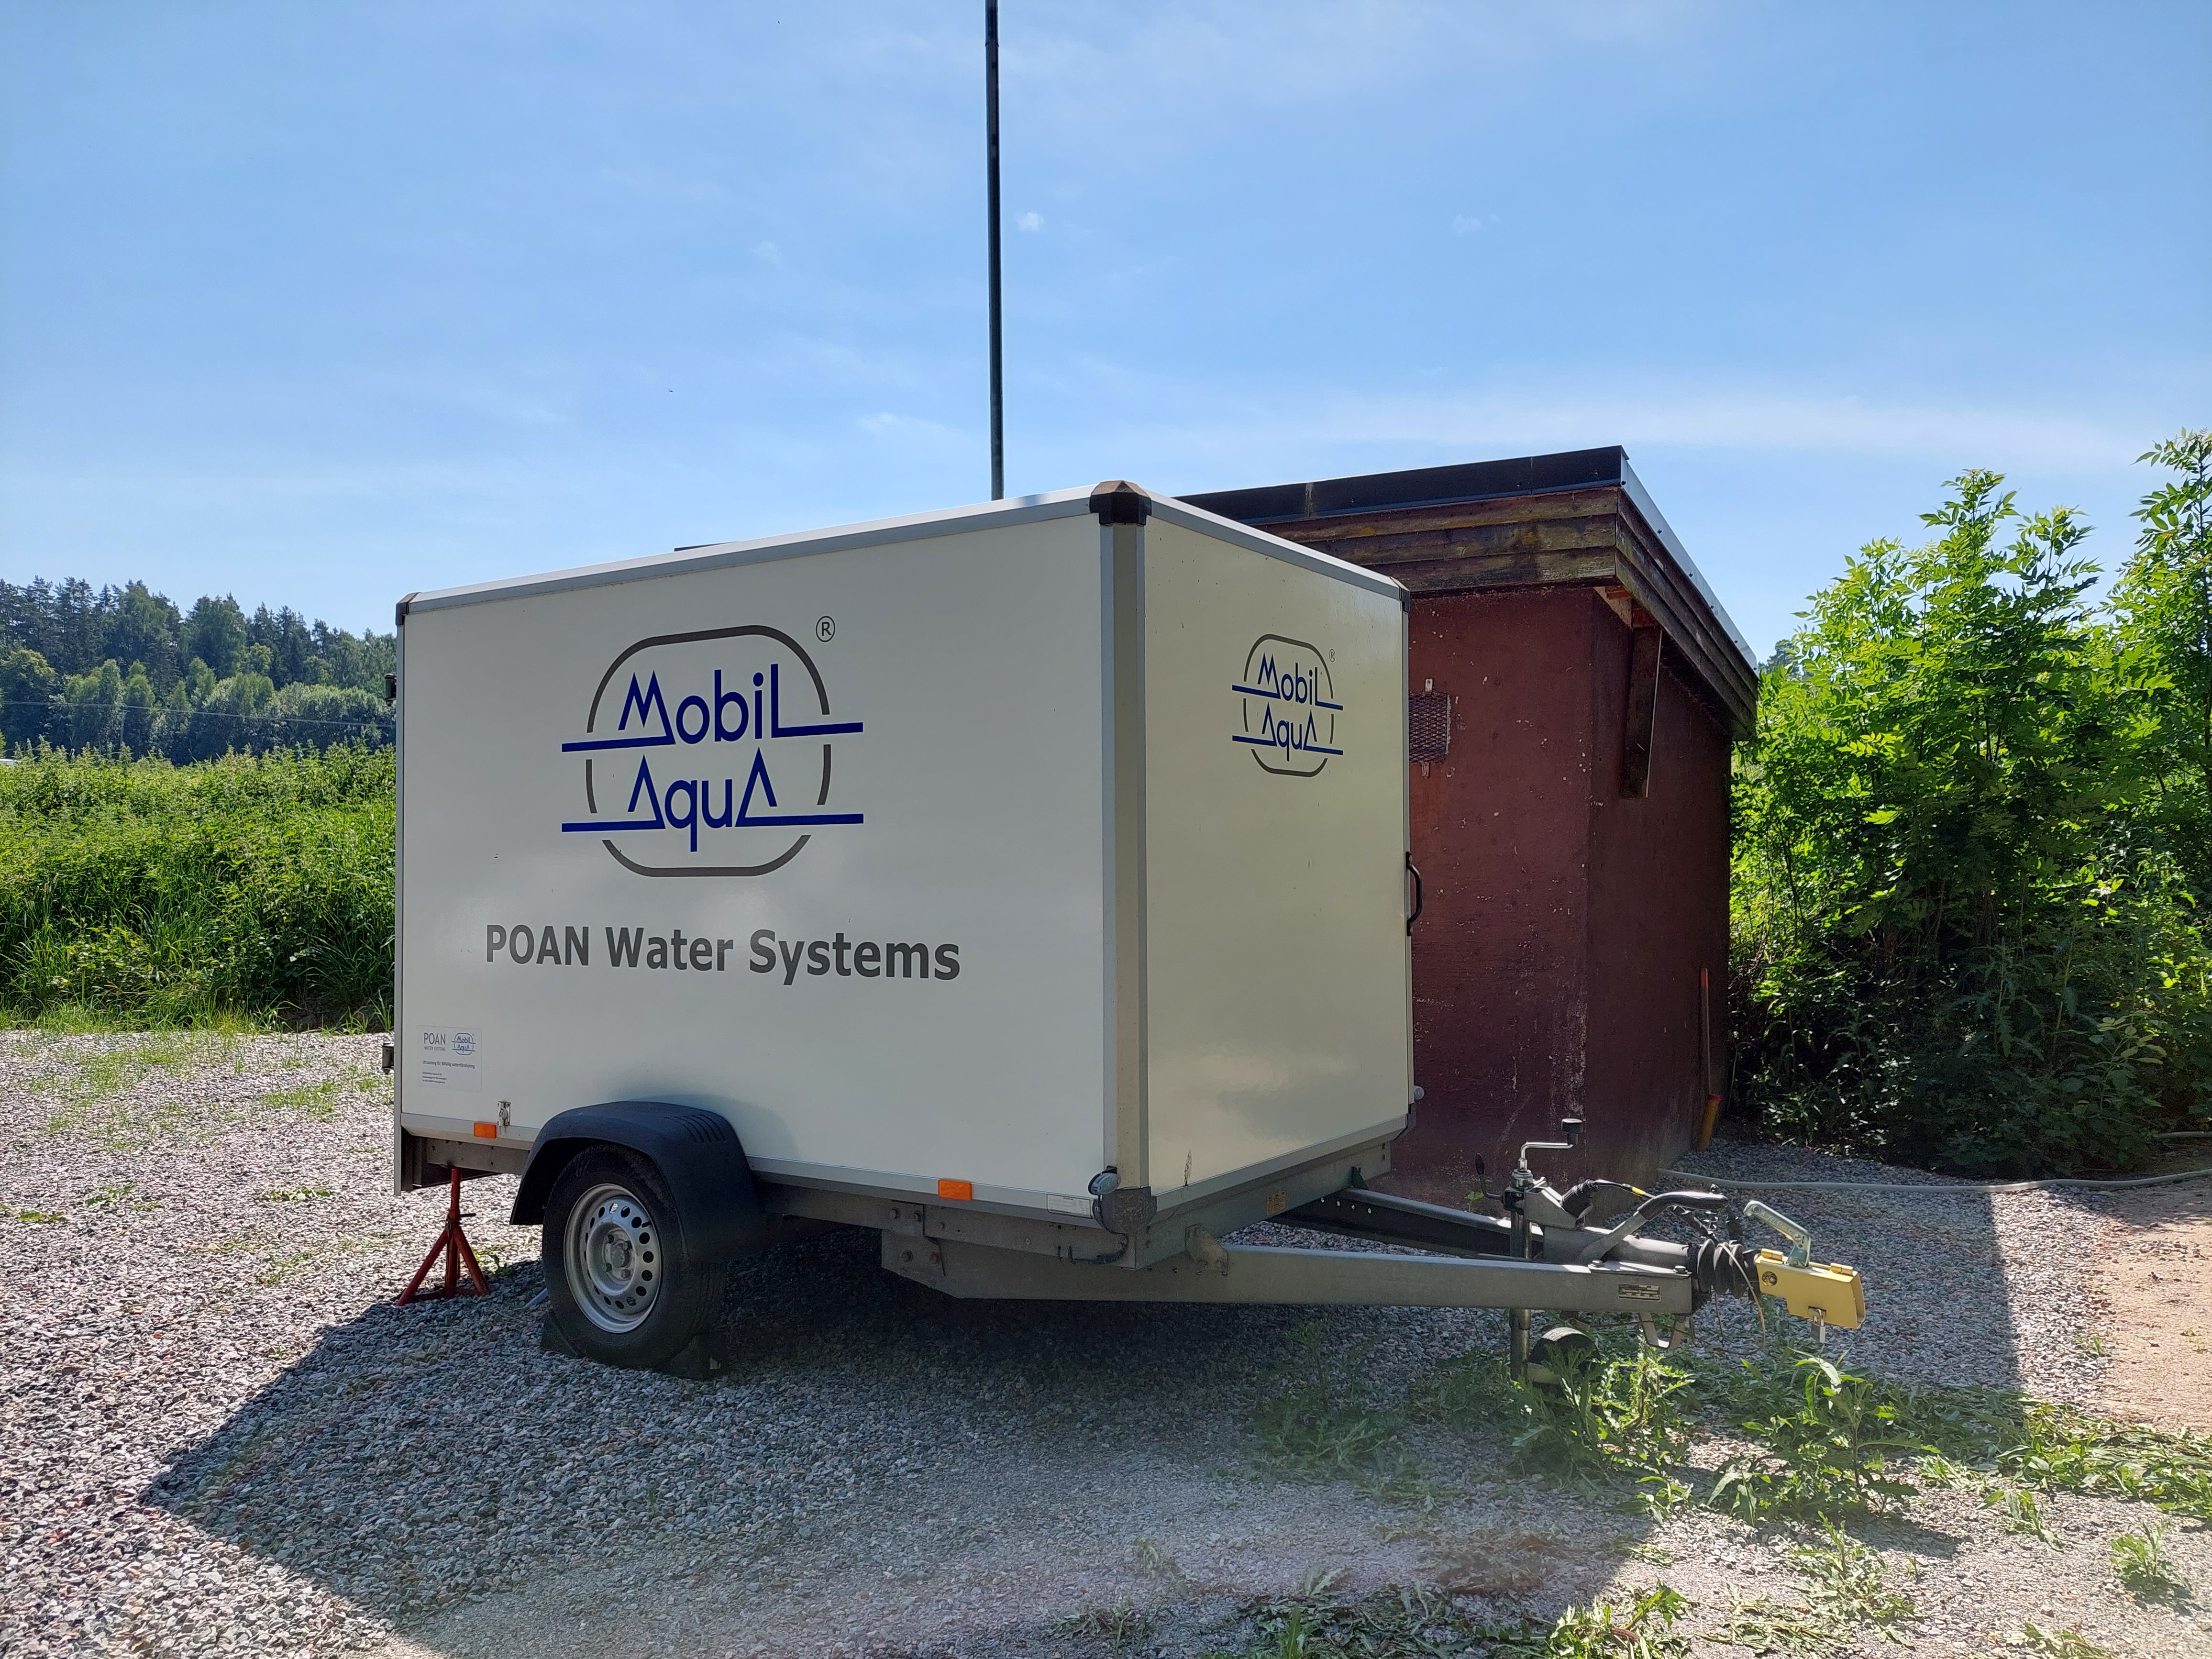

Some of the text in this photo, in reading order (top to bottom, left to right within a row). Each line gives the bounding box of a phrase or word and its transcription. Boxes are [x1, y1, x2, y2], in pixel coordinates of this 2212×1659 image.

[486, 924, 960, 985] POAN Water Systems
[424, 1032, 446, 1045] POAN
